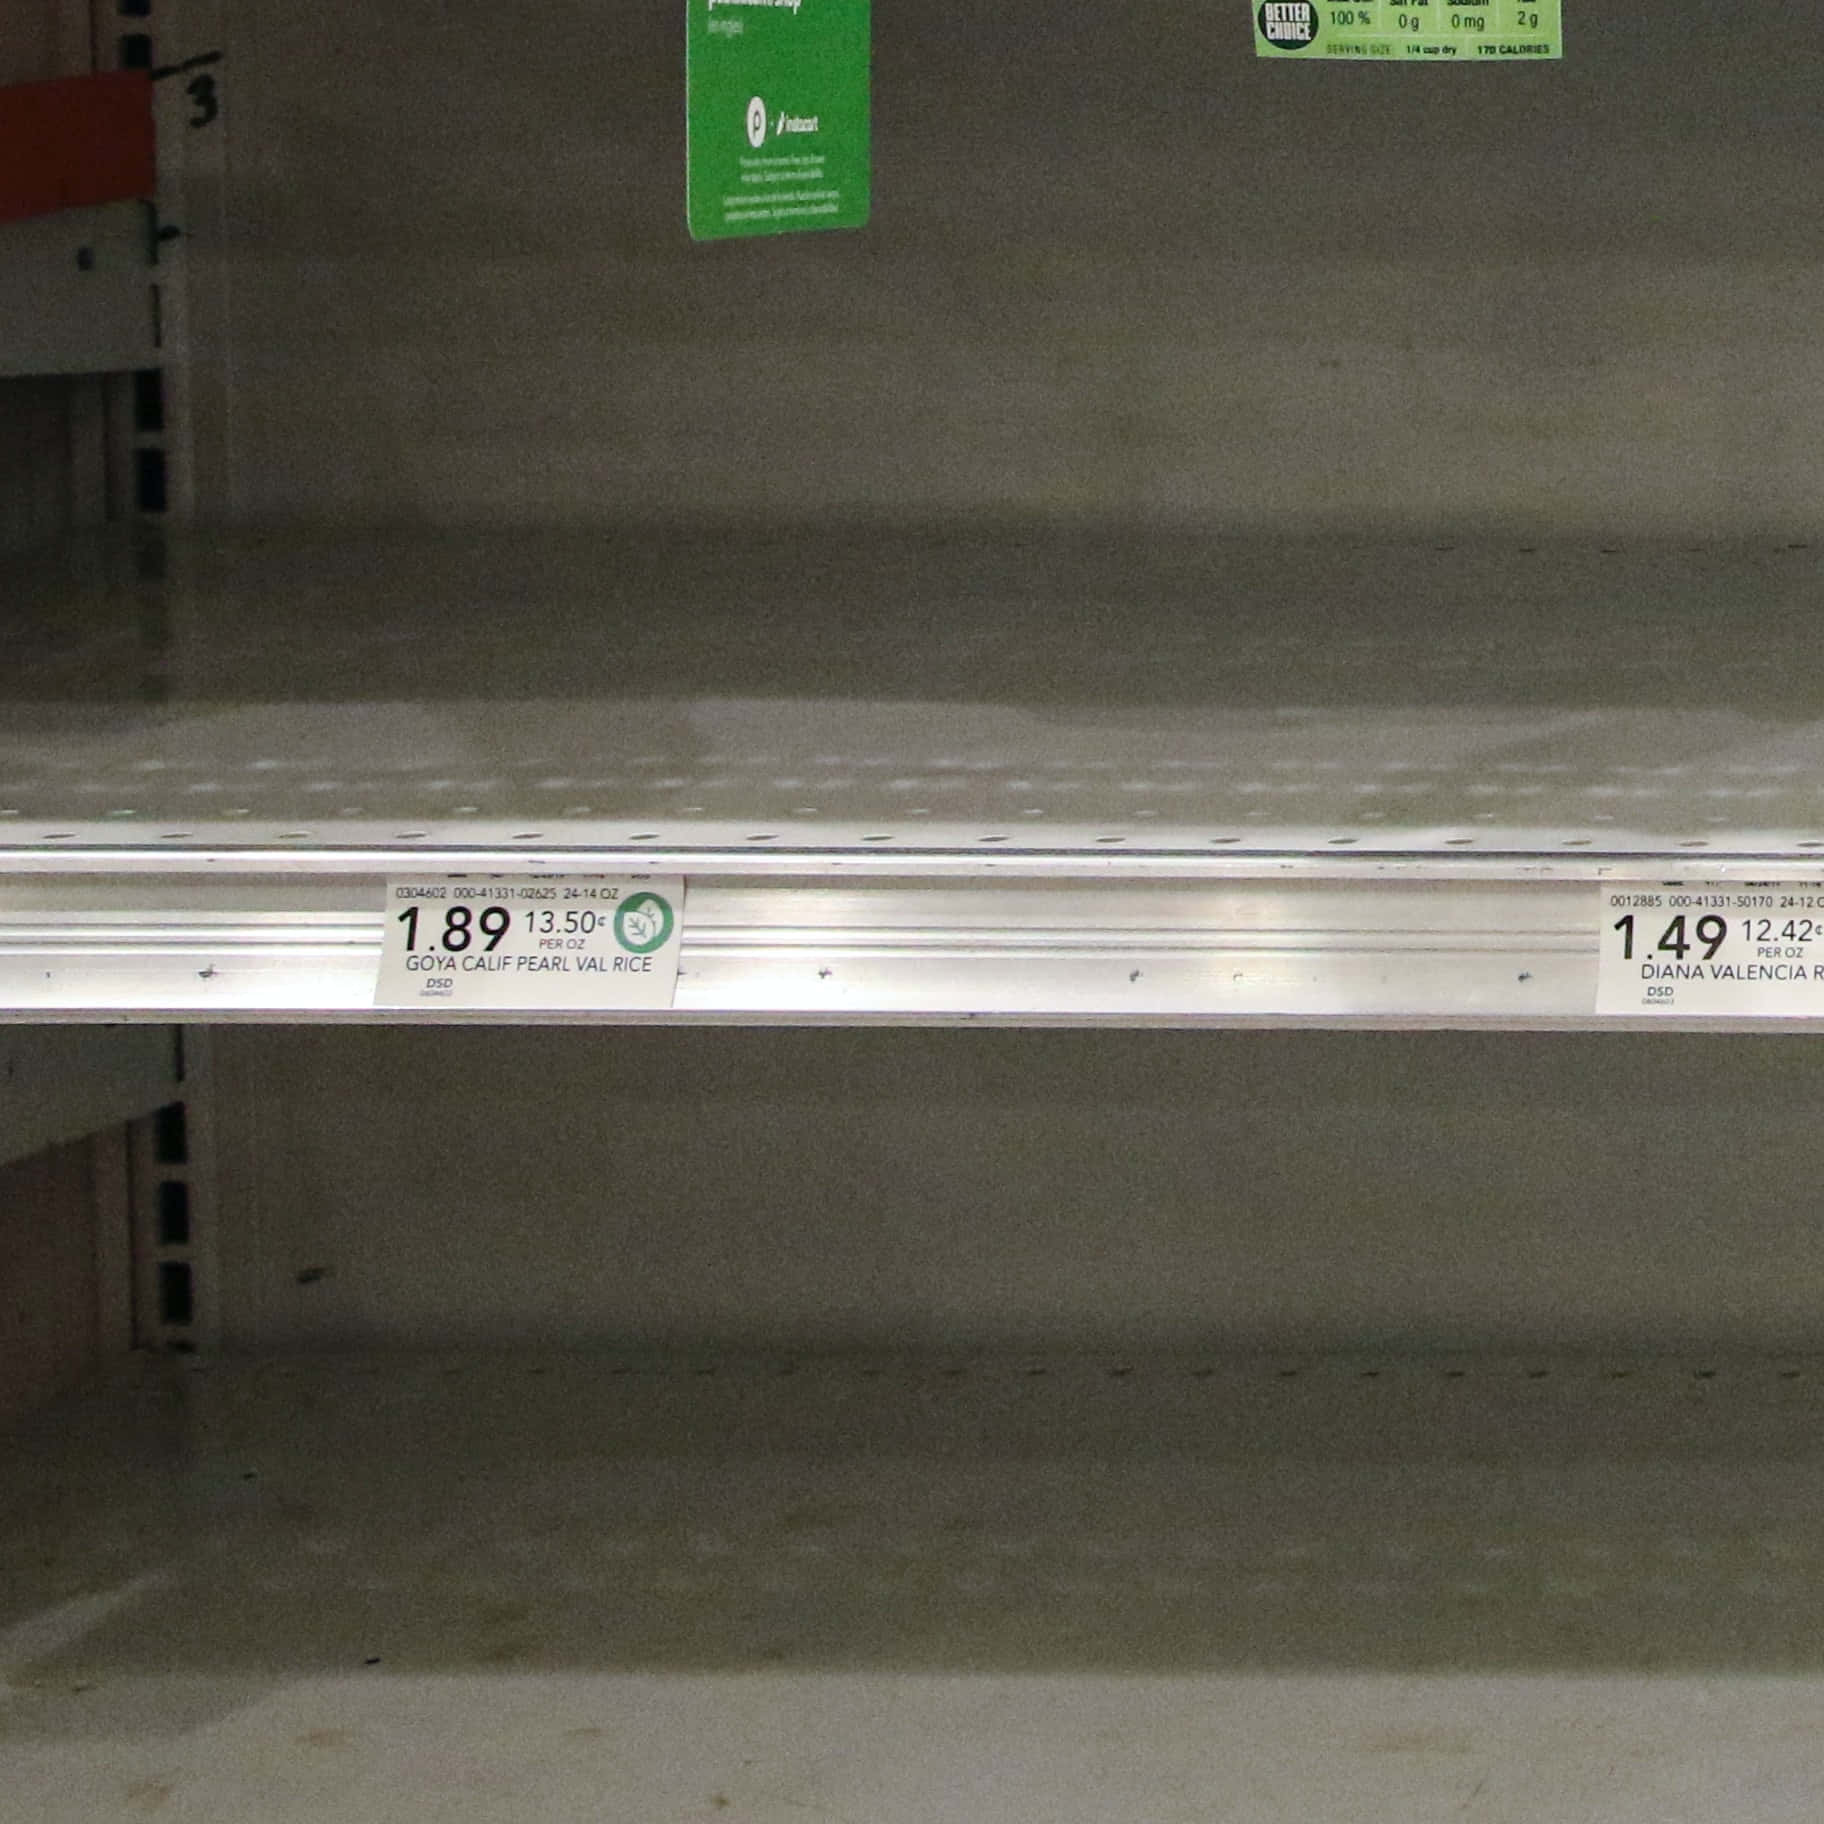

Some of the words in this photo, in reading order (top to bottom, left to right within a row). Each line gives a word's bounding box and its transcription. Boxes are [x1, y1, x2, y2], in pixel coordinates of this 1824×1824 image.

[187, 73, 218, 127] 3
[397, 905, 511, 952] 1.89
[525, 911, 607, 934] 13.50¢
[1741, 919, 1823, 942] 12.42¢
[1613, 914, 1728, 961] 1.49
[406, 956, 456, 971] GOYA
[462, 956, 513, 972] CALIF
[517, 956, 569, 972] PEARL
[576, 956, 608, 972] VAL
[613, 956, 653, 972] RICE
[1641, 964, 1704, 980] DIANA
[1711, 965, 1808, 980] VALENCIA
